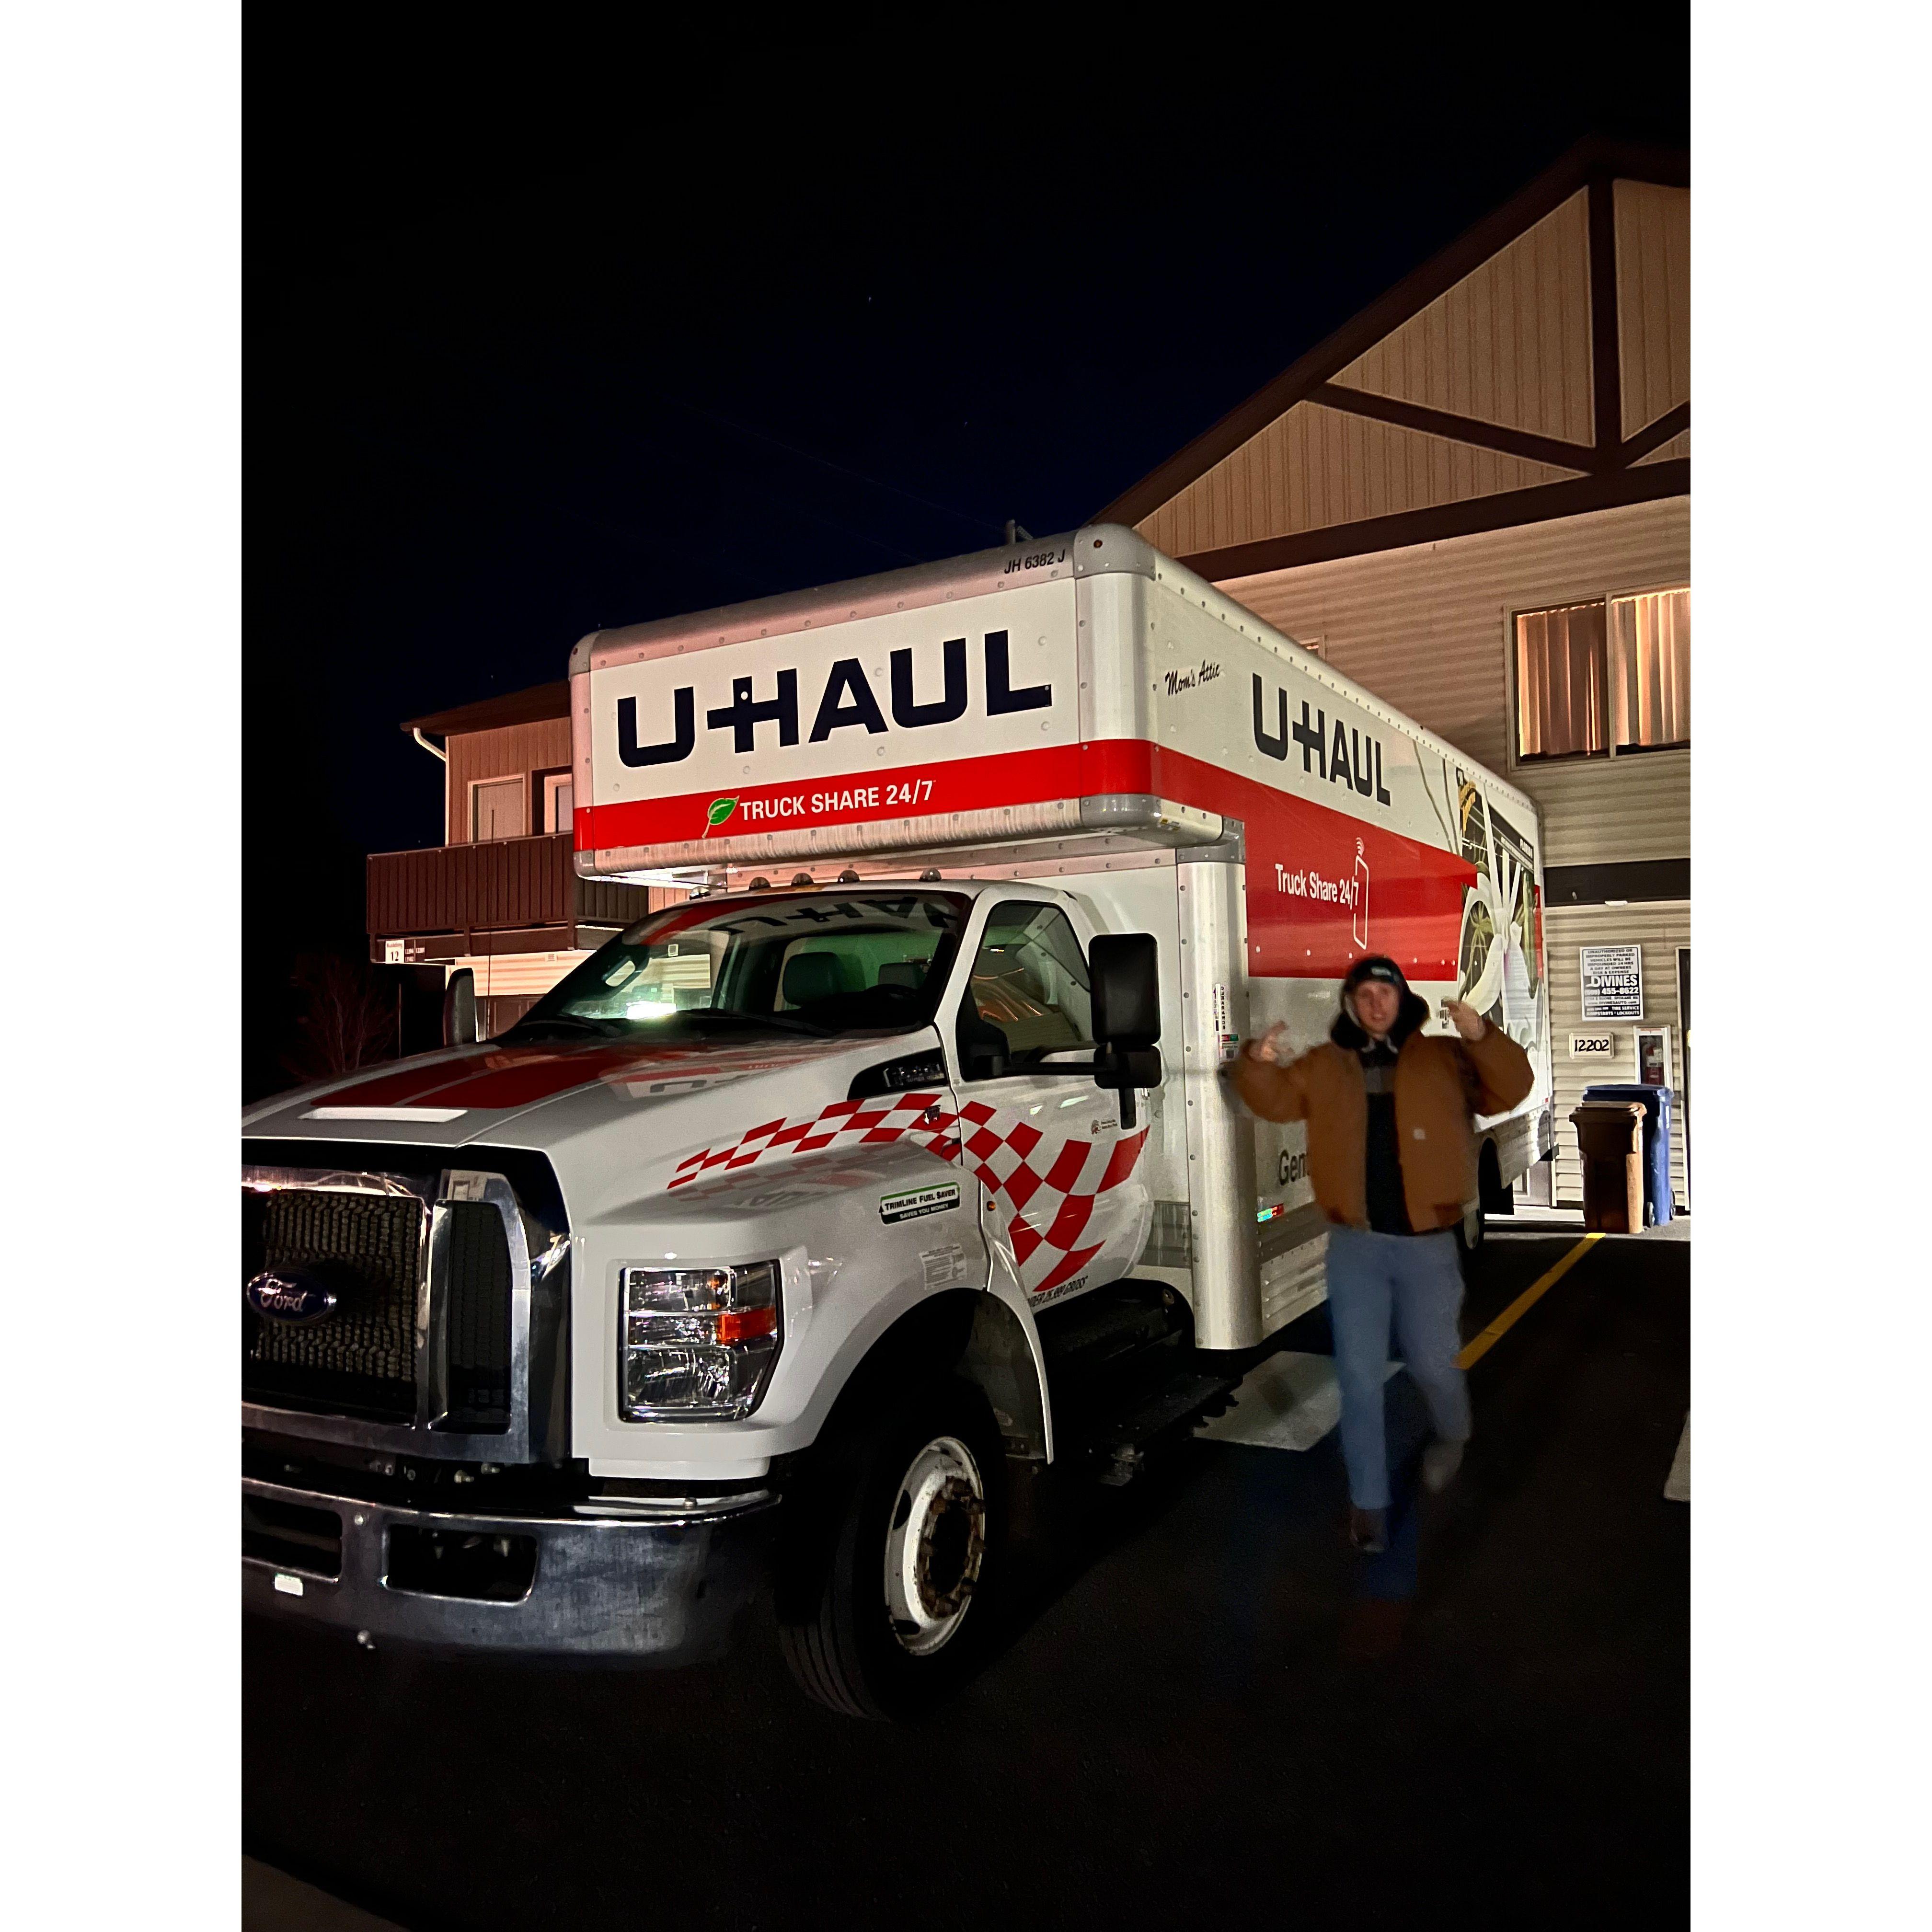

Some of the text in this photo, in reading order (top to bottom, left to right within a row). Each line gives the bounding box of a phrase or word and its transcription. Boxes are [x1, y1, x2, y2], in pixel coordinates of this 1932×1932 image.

[1004, 549, 1065, 574] JH 6382 J
[1165, 659, 1220, 696] Mom's Attic
[617, 629, 1052, 768] U-HAUL
[1253, 672, 1391, 807] U-HAUL
[740, 779, 933, 821] TRUCK SHARE 24/7
[1275, 863, 1359, 910] Truck Share 24/7
[391, 951, 399, 961] 12
[1586, 975, 1638, 987] DIVINES
[1601, 987, 1639, 995] 455-8622
[1575, 1039, 1609, 1052] 12202
[1279, 1149, 1310, 1186] Gen
[919, 1194, 935, 1203] FUEL
[936, 1189, 955, 1199] SAVER
[899, 1210, 918, 1219] SAVES
[931, 1203, 949, 1212] MONEY
[255, 1279, 309, 1312] Ford
